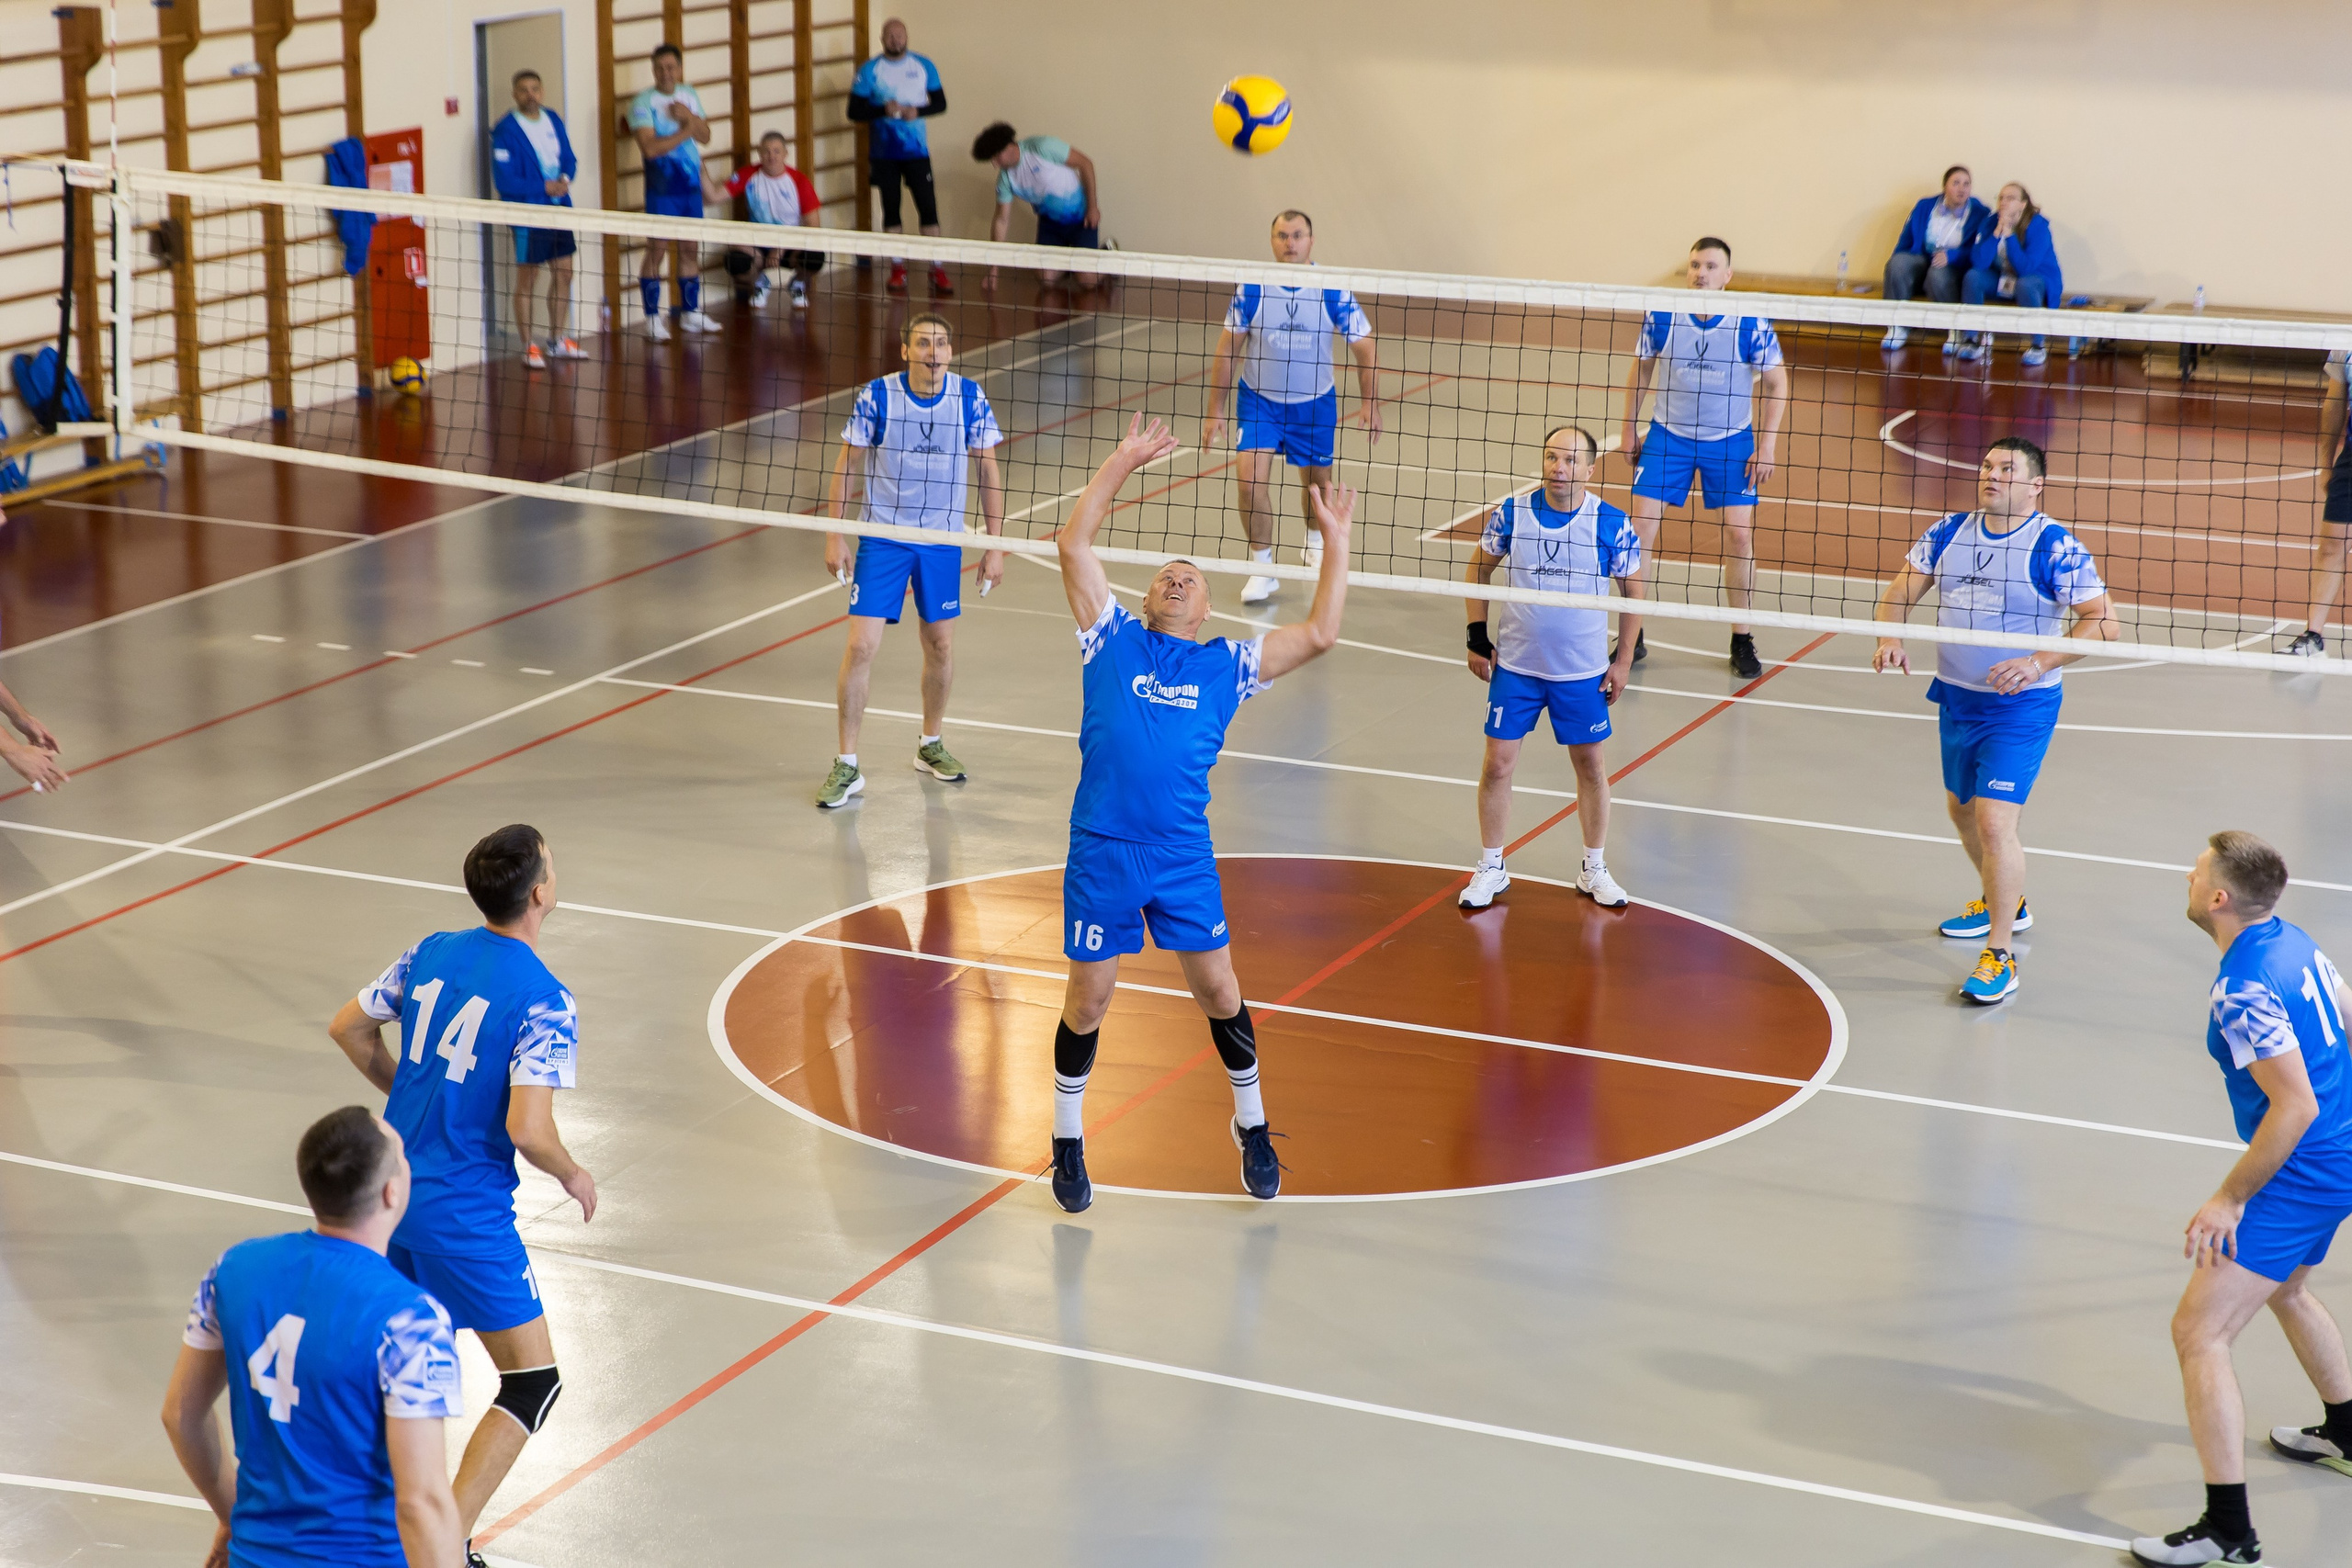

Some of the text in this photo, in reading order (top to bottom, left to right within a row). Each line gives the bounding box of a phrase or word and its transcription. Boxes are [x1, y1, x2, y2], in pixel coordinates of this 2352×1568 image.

[1531, 565, 1571, 577] JÖGEL
[1956, 573, 1995, 588] JÖGEL
[850, 582, 860, 606] 3
[1074, 919, 1104, 952] 16
[408, 976, 491, 1085] 14
[247, 1313, 306, 1425] 4
